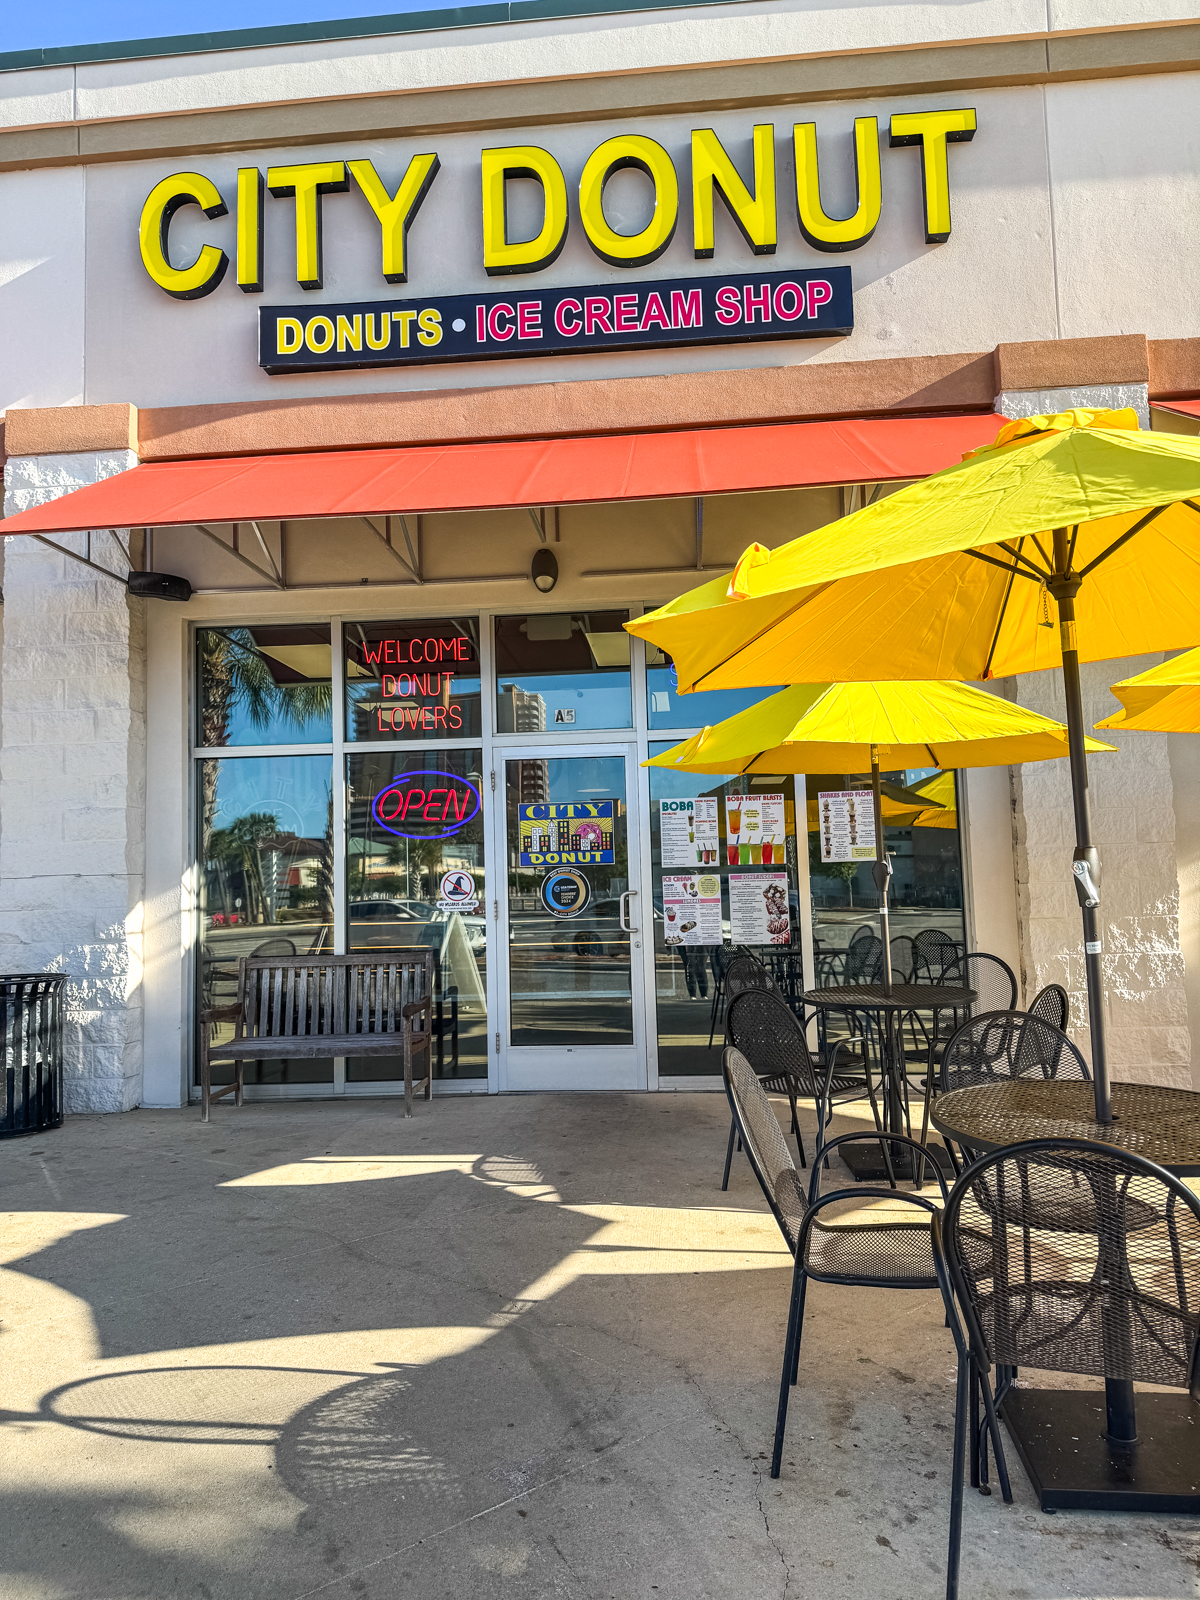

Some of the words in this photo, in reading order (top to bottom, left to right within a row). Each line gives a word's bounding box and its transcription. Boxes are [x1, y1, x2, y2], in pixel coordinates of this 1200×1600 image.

[139, 152, 441, 299] CITY
[482, 108, 977, 277] DONUT
[276, 308, 443, 355] DONUTS
[475, 301, 543, 343] ICE
[554, 288, 703, 337] CREAM
[715, 279, 833, 327] SHOP
[362, 637, 470, 664] WELCOME
[382, 671, 455, 698] DONUT
[377, 705, 463, 732] LOVERS
[555, 709, 575, 723] A5
[378, 788, 471, 822] OPEN
[525, 803, 606, 819] CITY
[662, 801, 693, 811] BOBA
[529, 851, 604, 865] DONUT
